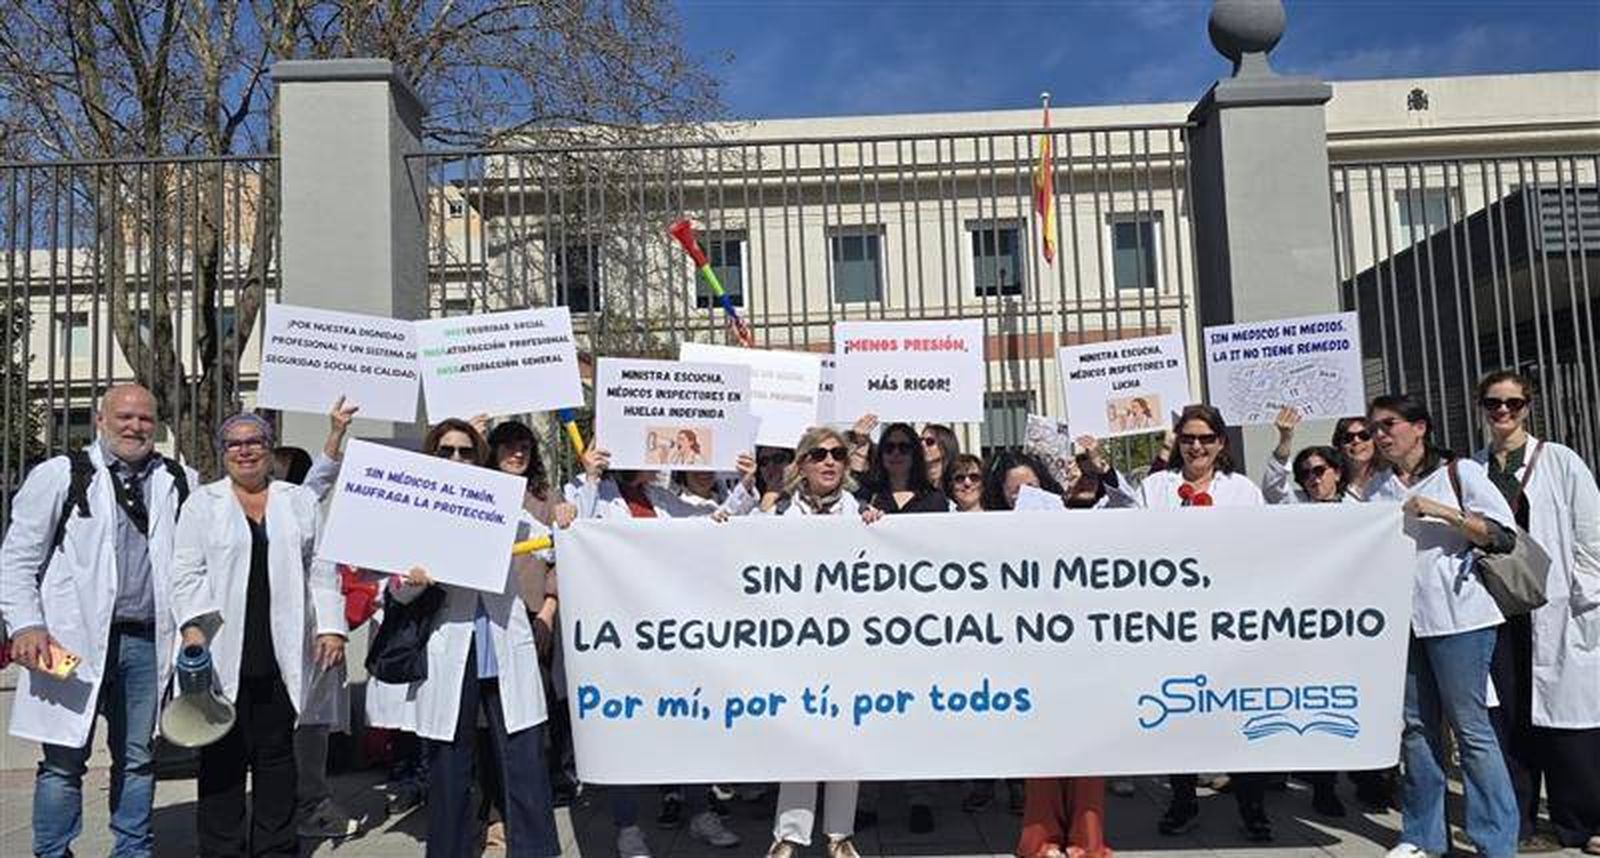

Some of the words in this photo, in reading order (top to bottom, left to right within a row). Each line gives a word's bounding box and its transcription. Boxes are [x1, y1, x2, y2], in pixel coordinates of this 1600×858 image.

[314, 323, 357, 336] NUESTRA
[359, 328, 405, 341] DIGNIDAD
[513, 320, 544, 330] SOCIAL
[509, 335, 569, 348] PROFESIONAL
[1211, 333, 1229, 345] SIN
[1231, 326, 1280, 342] MEDICOS
[1283, 325, 1297, 337] NI
[271, 335, 339, 350] PROFESIONAL
[341, 343, 348, 351] Y
[350, 345, 363, 353] UN
[365, 347, 404, 360] SISTEMA
[844, 338, 898, 354] ¡MENOS
[1080, 351, 1118, 362] MINISTRA
[1121, 345, 1162, 358] ESCUCHA,
[1213, 350, 1228, 363] LA
[1230, 349, 1241, 361] IT
[1243, 348, 1259, 360] NO
[1262, 344, 1294, 358] TIENE
[1299, 339, 1350, 355] REMEDIO
[265, 354, 321, 368] SEGURIDAD
[324, 361, 358, 373] SOCIAL
[360, 366, 372, 374] DE
[521, 354, 563, 366] GENERAL
[622, 370, 671, 381] MINISTRA
[674, 372, 725, 384] ESCUCHA,
[1070, 367, 1106, 380] MÉDICOS
[1109, 360, 1164, 375] INSPECTORES
[1167, 359, 1178, 369] EN
[868, 374, 899, 391] MÁS
[904, 377, 951, 392] RIGOR!
[1112, 379, 1140, 391] LUCHA
[607, 386, 653, 399] MÉDICOS
[655, 388, 724, 401] INSPECTORES
[727, 392, 741, 402] EN
[623, 405, 665, 417] HUELGA
[668, 407, 724, 419] INDEFINIDA
[365, 467, 383, 479] SIN
[387, 470, 437, 491] MÉDICOS
[441, 483, 456, 495] AL
[460, 487, 496, 505] TIMÓN,
[344, 482, 410, 504] NAUFRAGA
[414, 497, 429, 509] LA
[742, 564, 801, 595] SIN
[814, 550, 989, 594] MÉDICOS
[1000, 558, 1040, 589] NI
[1053, 556, 1211, 590] MEDIOS,
[573, 619, 622, 652] LA
[635, 616, 851, 651] SEGURIDAD
[863, 613, 1003, 647] SOCIAL
[1015, 612, 1075, 644] NO
[1087, 609, 1199, 644] TIENE
[1211, 606, 1387, 641] REMEDIO
[577, 684, 643, 720] Por
[657, 687, 711, 721] mí,
[725, 691, 788, 729] por
[802, 684, 839, 718] tí,
[853, 689, 915, 726] por
[929, 678, 1032, 715] todos
